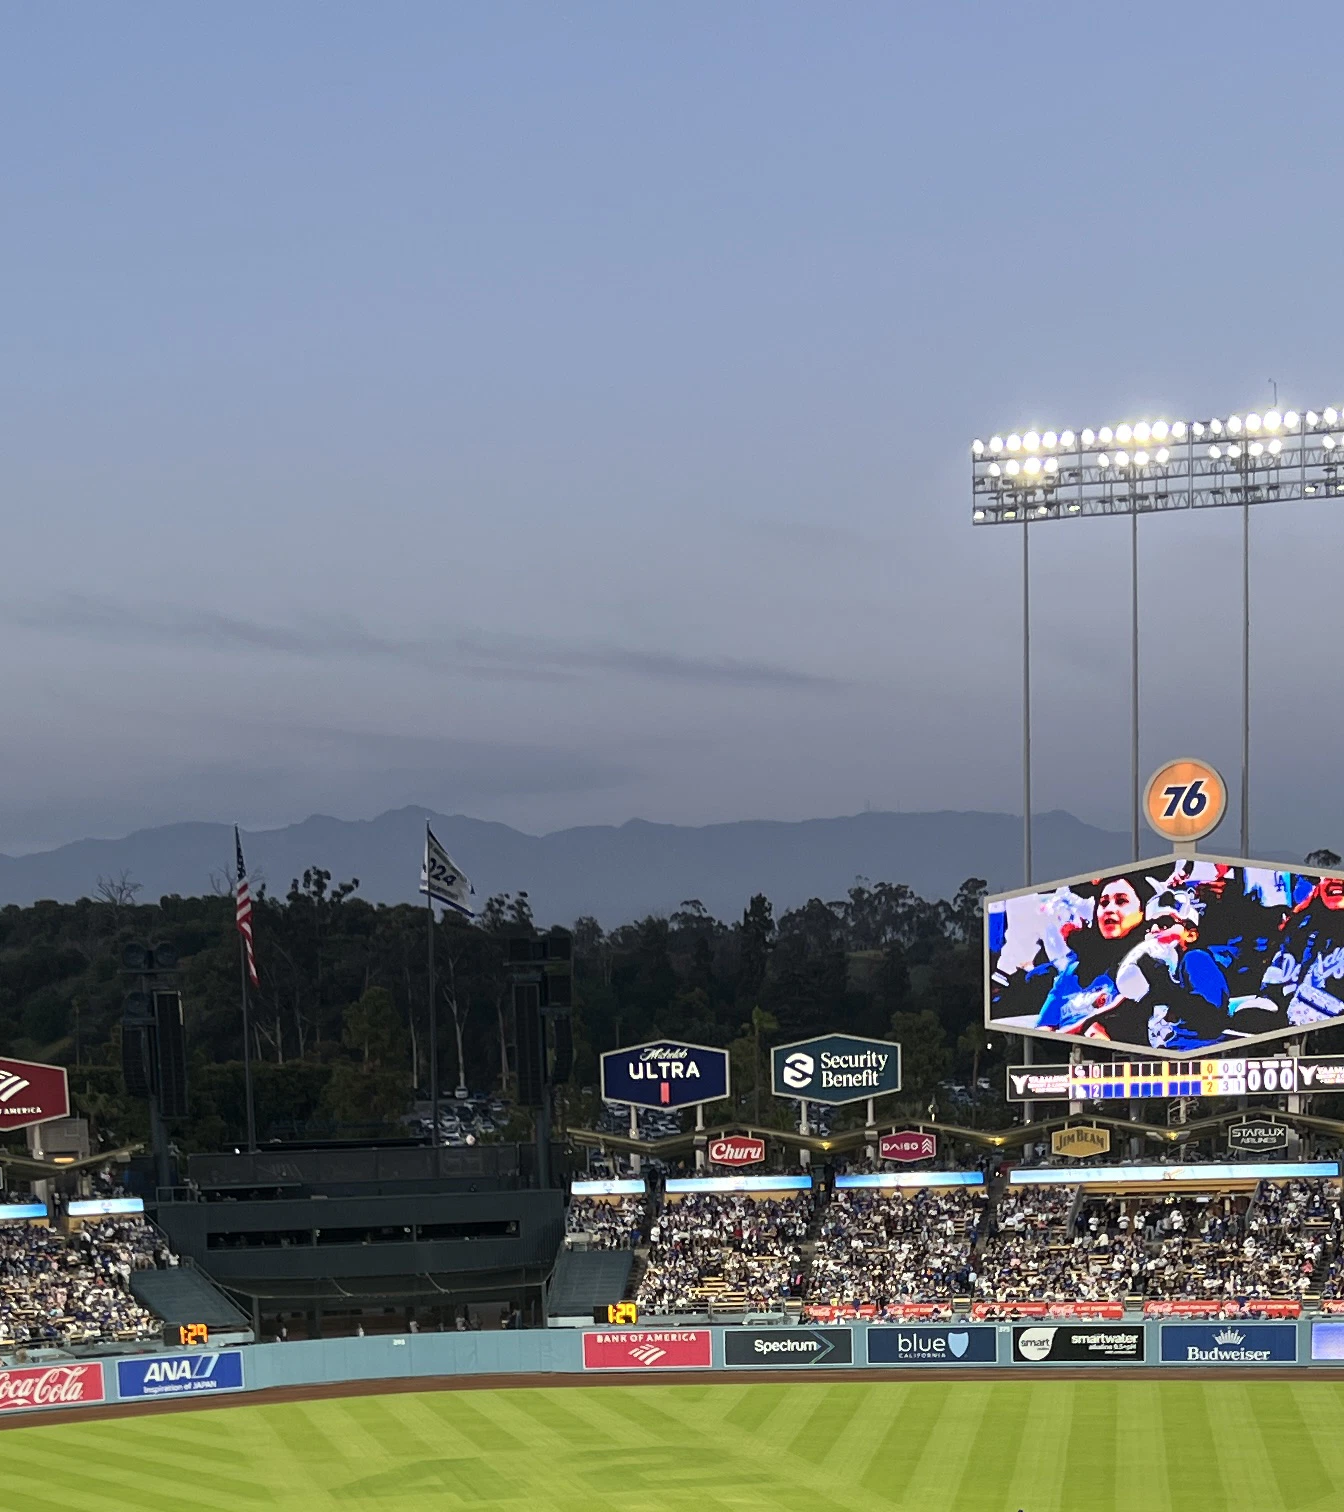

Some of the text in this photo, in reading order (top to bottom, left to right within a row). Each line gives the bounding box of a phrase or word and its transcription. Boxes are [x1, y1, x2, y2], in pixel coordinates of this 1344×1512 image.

[1159, 777, 1210, 820] 76
[628, 1060, 701, 1080] ULTRA
[820, 1050, 889, 1071] Security
[821, 1069, 880, 1089] Benefit
[3, 1106, 42, 1115] AMERICA
[1056, 1129, 1105, 1151] JIM BEAM
[1232, 1127, 1285, 1137] STARLUX
[711, 1142, 763, 1161] Churu
[882, 1141, 919, 1152] DAISO
[607, 1302, 638, 1324] 1:29
[179, 1323, 208, 1345] 1:29
[597, 1333, 697, 1343] BANK OF AMERICA
[897, 1333, 946, 1352] blue
[1020, 1338, 1050, 1347] smart
[1071, 1333, 1139, 1344] smartwater
[754, 1338, 818, 1355] Spectrum
[1187, 1346, 1271, 1360] Budweiser
[143, 1359, 192, 1383] ANA
[143, 1384, 183, 1395] Inspiration
